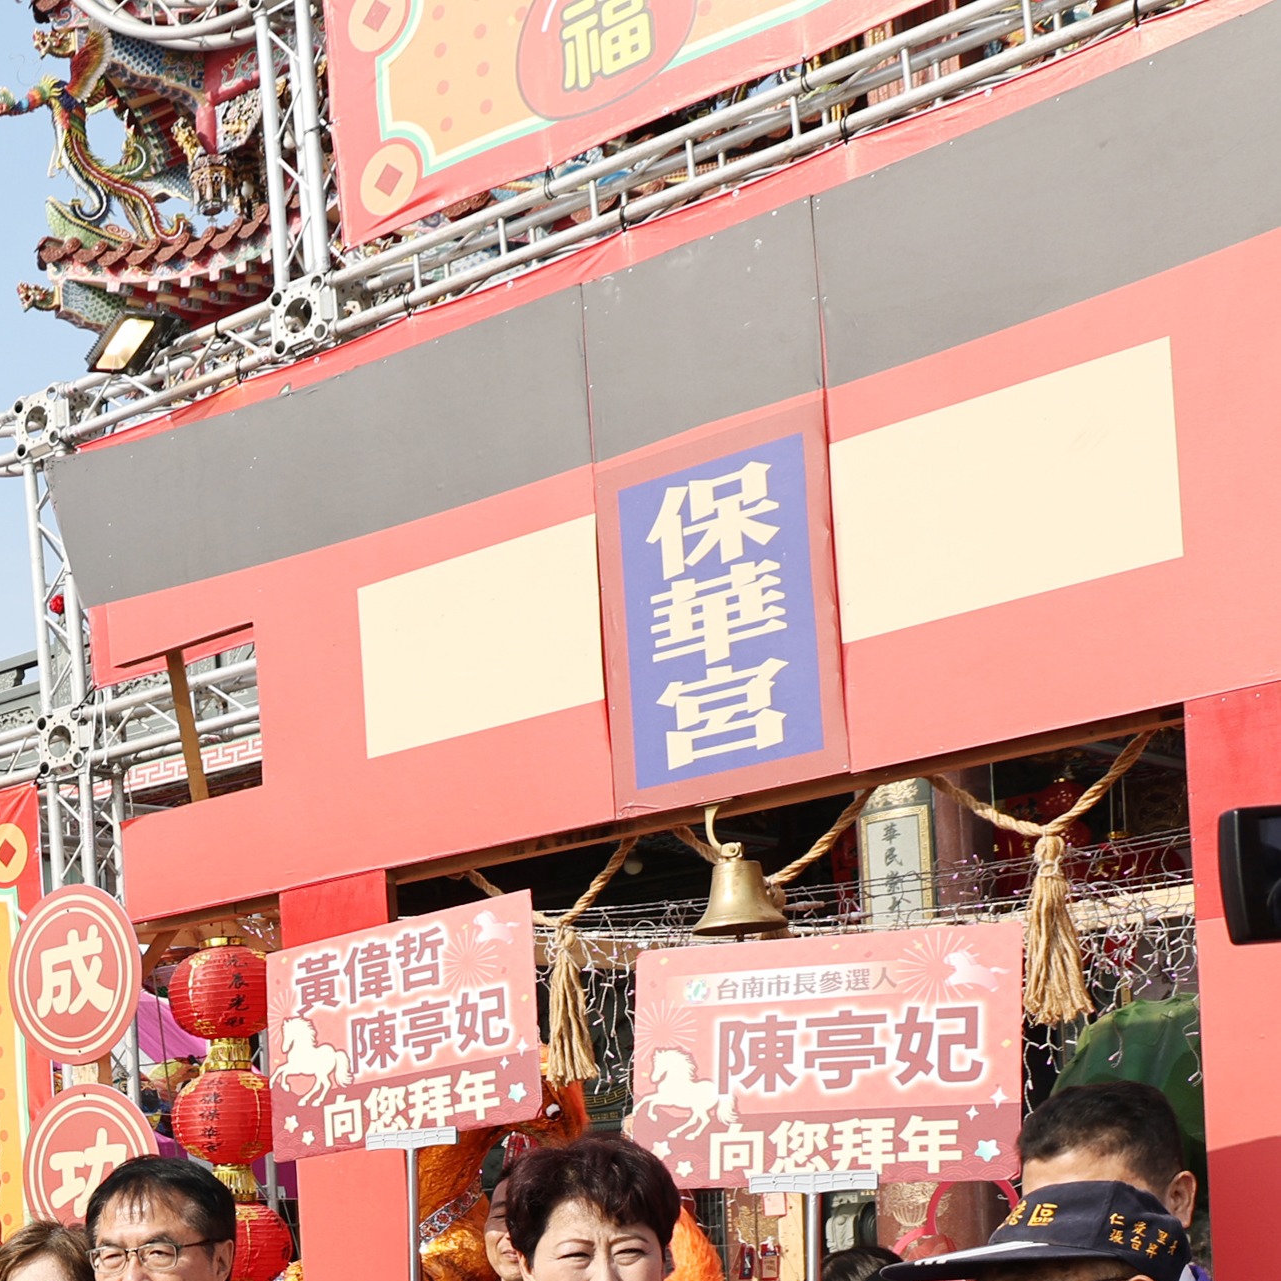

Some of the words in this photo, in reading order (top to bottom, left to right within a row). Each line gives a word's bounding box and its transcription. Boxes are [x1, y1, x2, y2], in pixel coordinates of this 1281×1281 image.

[561, 0, 652, 90] 福
[646, 460, 789, 772] 保華宮
[37, 924, 115, 1018] 成
[294, 926, 446, 1018] 黃偉哲
[715, 965, 898, 1002] 台南市長參選人
[350, 986, 510, 1075] 陳亭妃
[717, 1006, 984, 1096] 陳亭妃
[323, 1070, 501, 1147] 向您拜年
[709, 1115, 963, 1181] 向您拜年
[48, 1127, 128, 1218] 功
